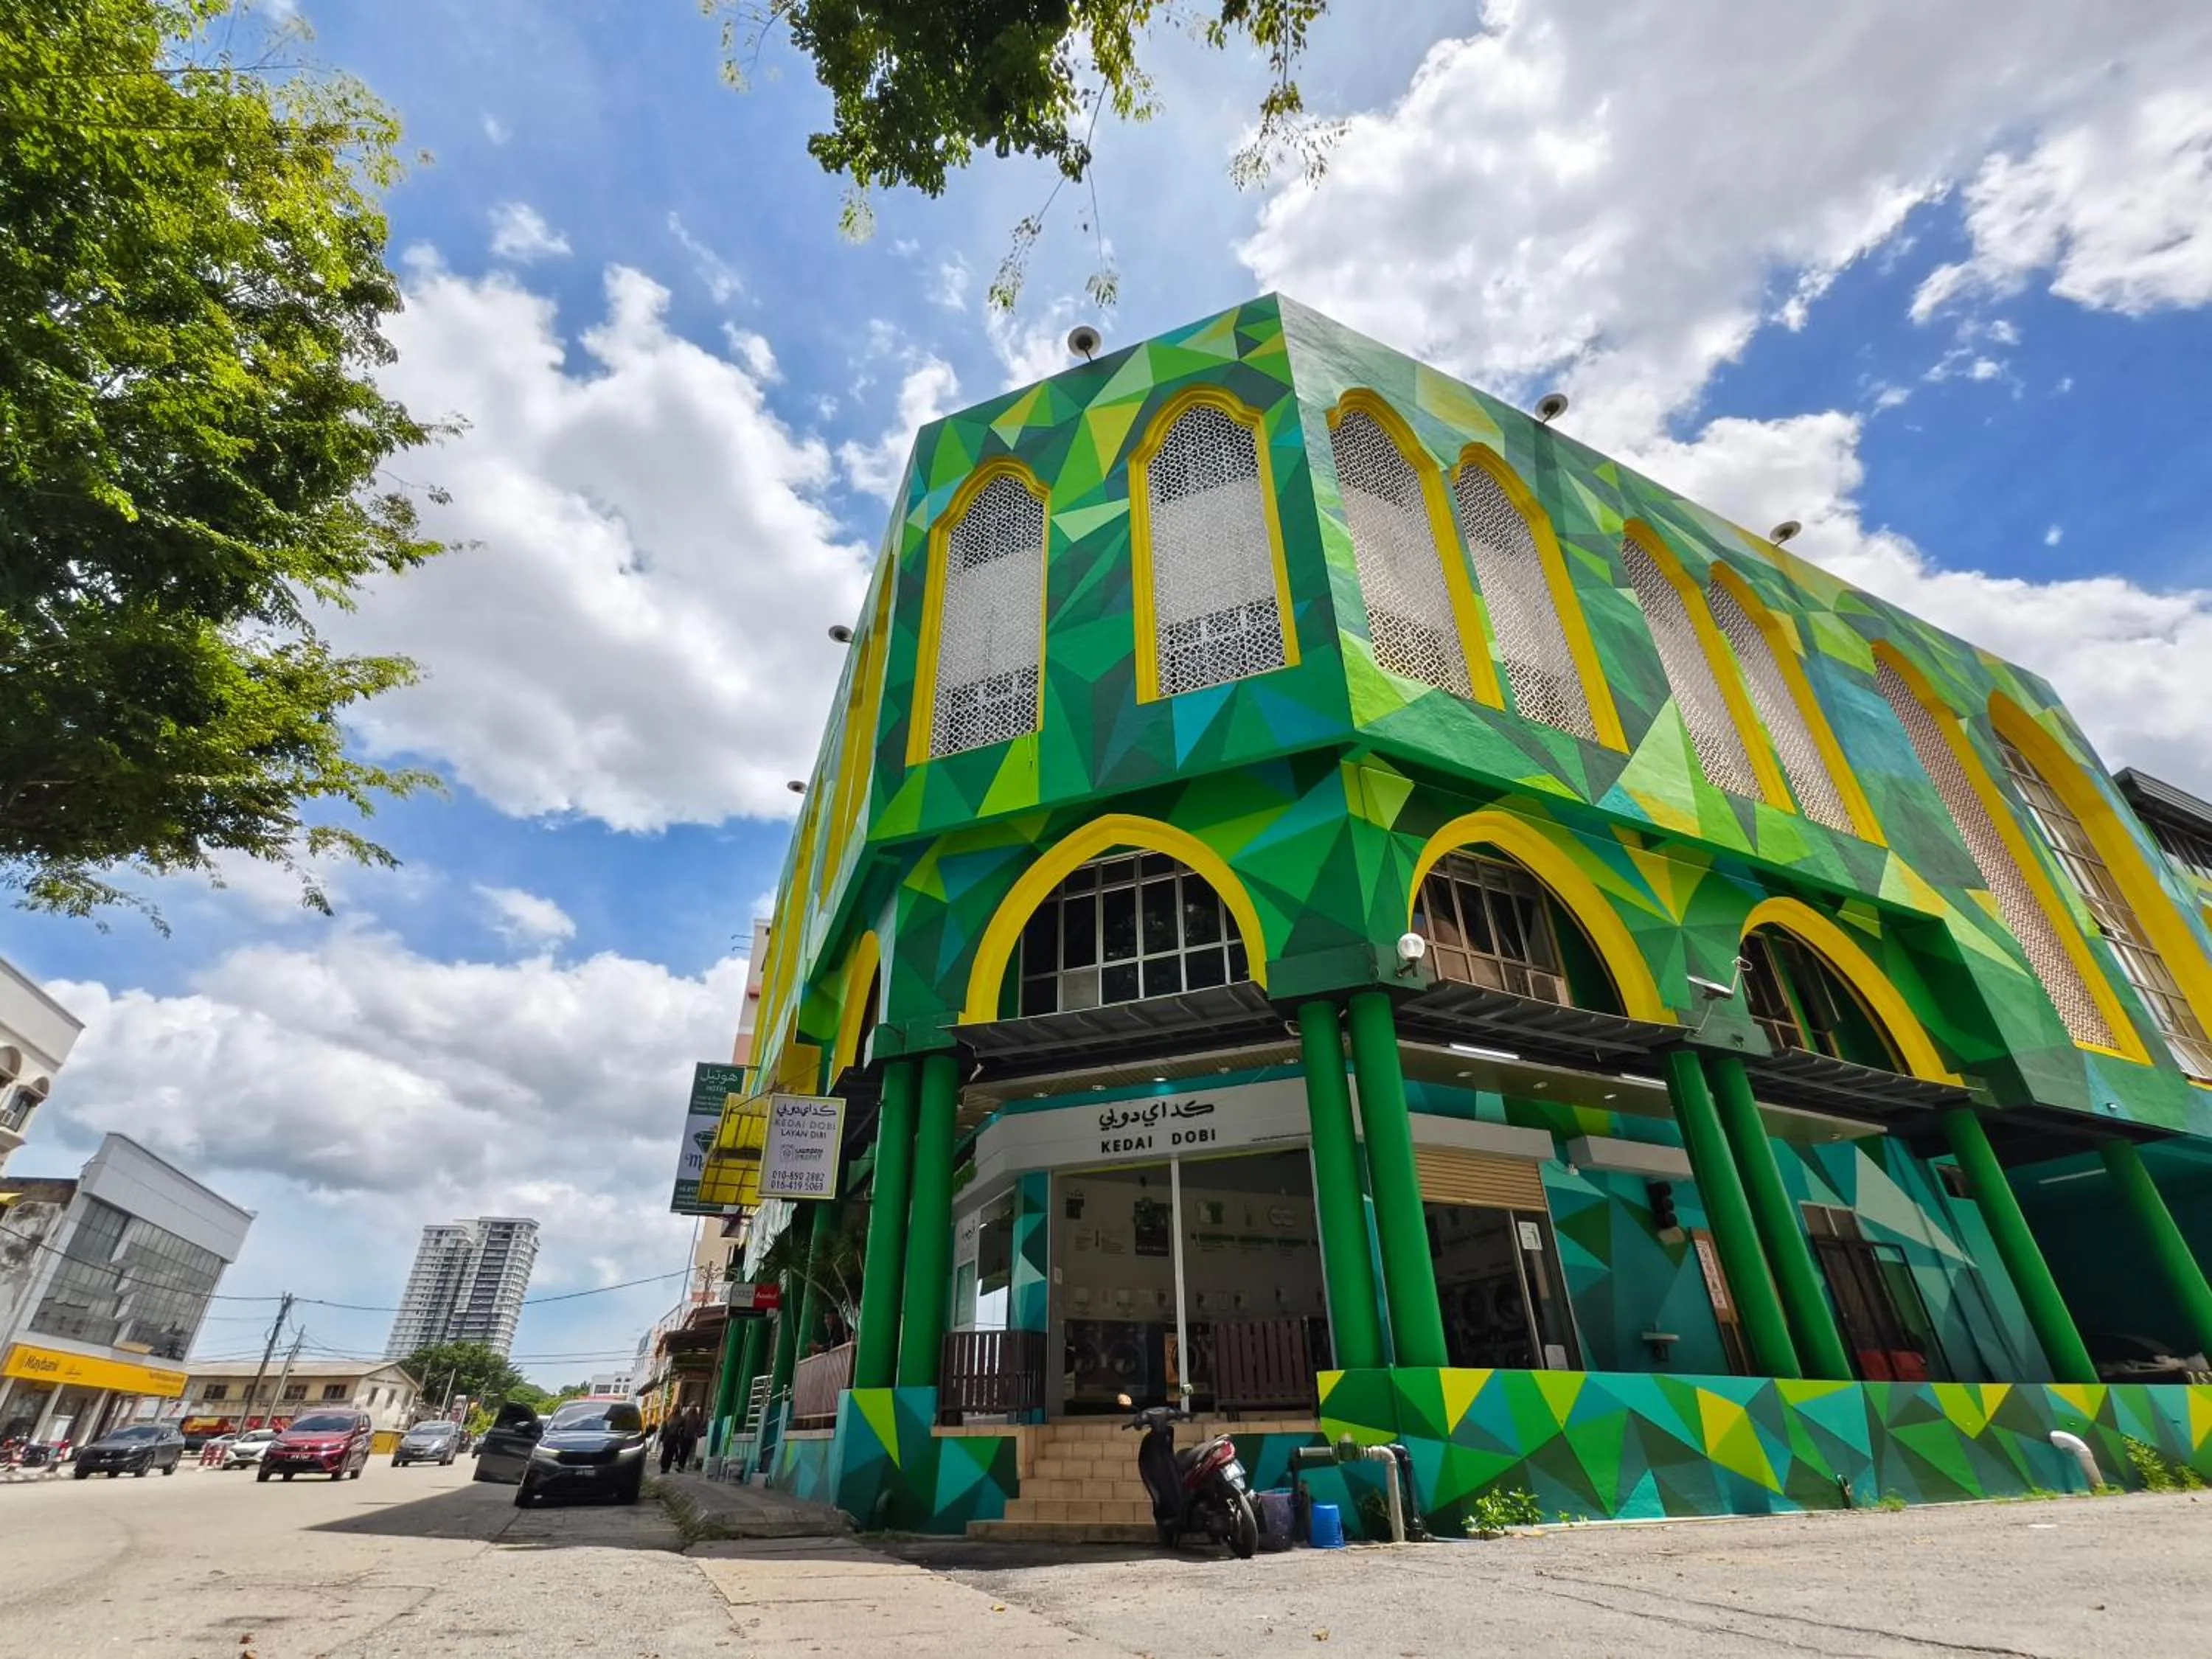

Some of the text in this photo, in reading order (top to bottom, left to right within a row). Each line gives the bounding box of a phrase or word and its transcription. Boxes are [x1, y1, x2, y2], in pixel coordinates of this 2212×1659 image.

[775, 1119, 835, 1130] KEDAI DOBI
[781, 1129, 807, 1137] LAYAN
[1101, 1128, 1216, 1153] KEDAI DOBI
